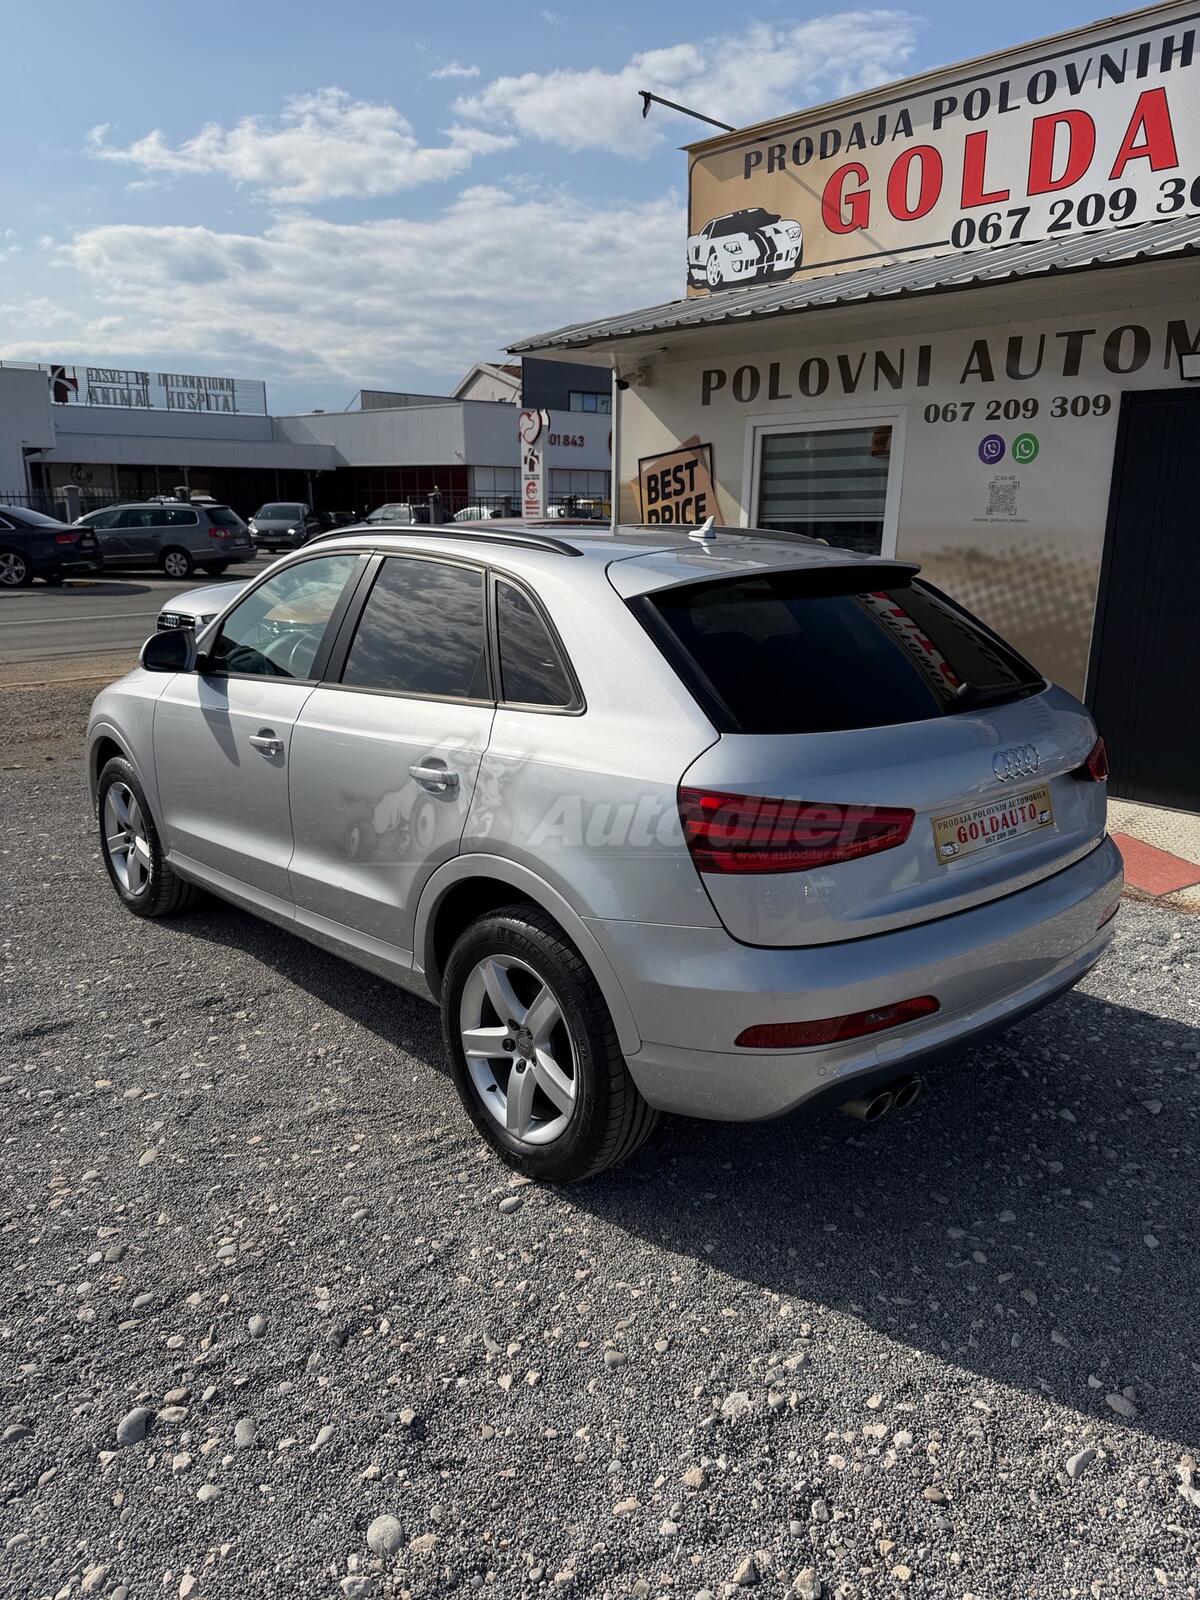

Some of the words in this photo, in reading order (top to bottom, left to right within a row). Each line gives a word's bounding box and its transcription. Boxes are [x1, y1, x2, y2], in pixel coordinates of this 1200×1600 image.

[743, 109, 914, 180] PRODAJA
[932, 29, 1196, 131] POLOVNIH
[821, 86, 1179, 235] GOLDA
[951, 206, 1031, 249] 067
[1047, 187, 1137, 233] 209
[158, 373, 237, 393] INTERNATIONAL
[701, 345, 932, 406] POLOVNI
[90, 386, 154, 408] ANIMAL
[167, 391, 239, 413] HOSPITAL
[924, 401, 976, 424] 067
[985, 397, 1039, 421] 209
[1050, 394, 1112, 418] 309
[647, 459, 699, 505] BEST
[937, 813, 972, 831] PRODAJA
[972, 801, 1008, 819] POLOVNIH
[1008, 790, 1047, 808] AUTOMOBILA
[957, 803, 1038, 844] GOLDAUTO
